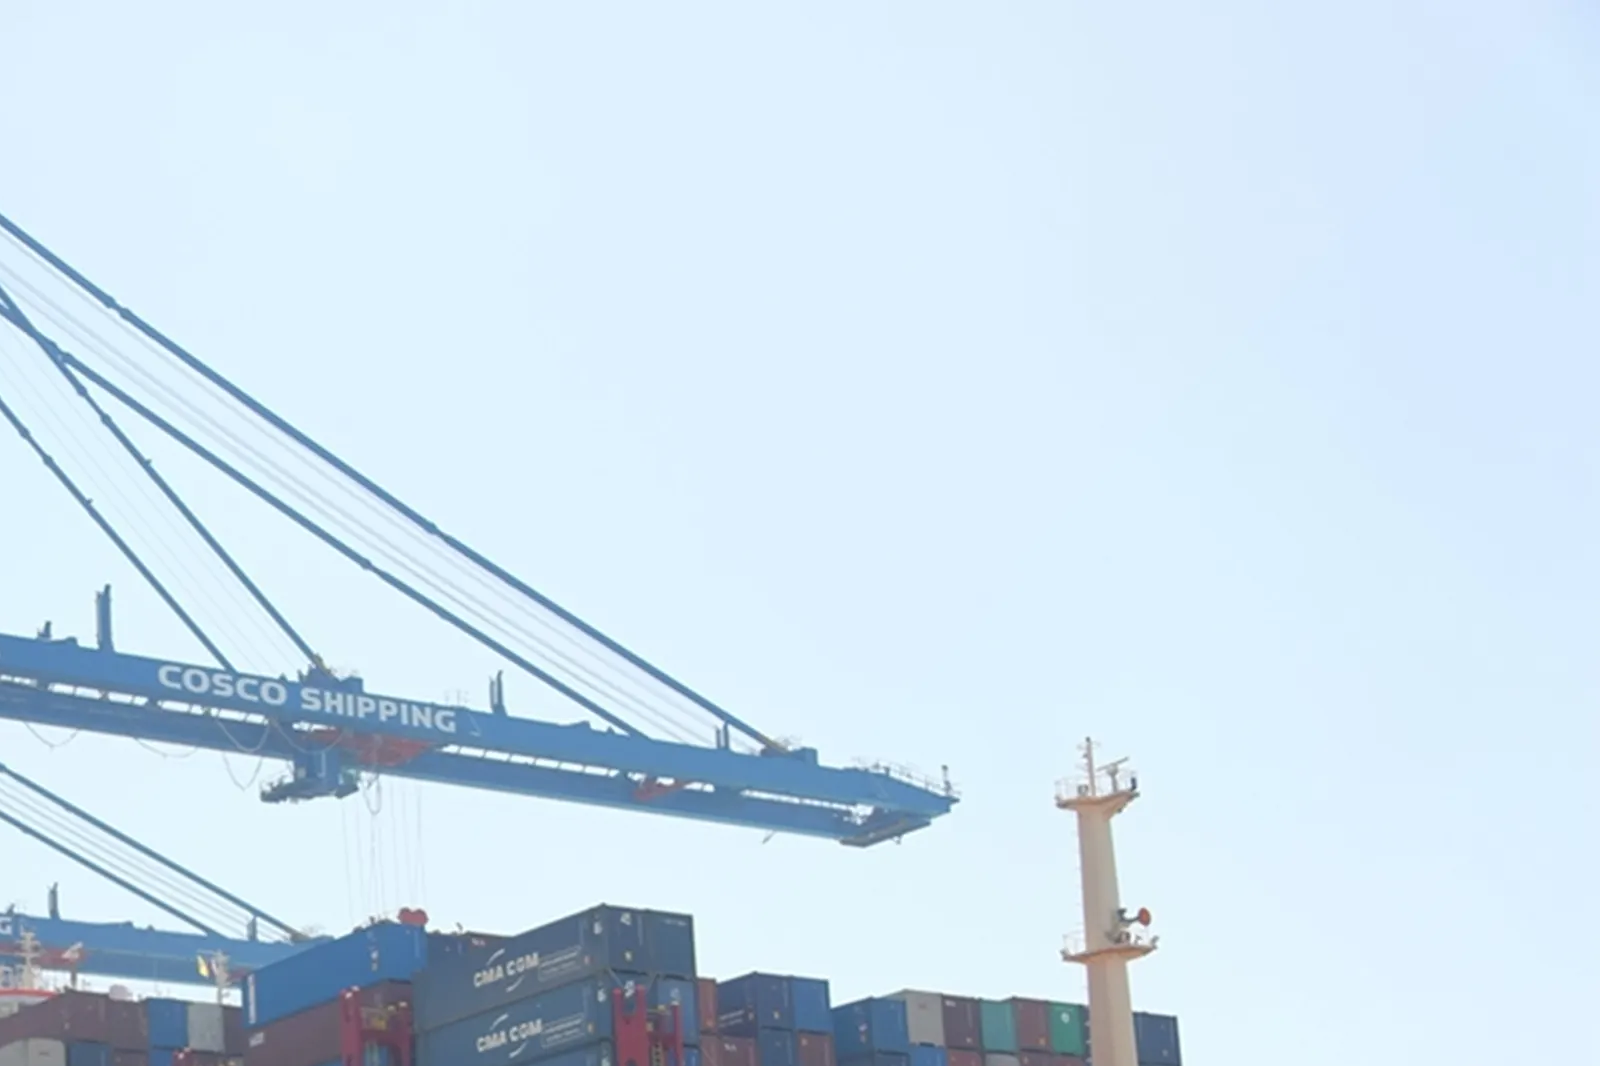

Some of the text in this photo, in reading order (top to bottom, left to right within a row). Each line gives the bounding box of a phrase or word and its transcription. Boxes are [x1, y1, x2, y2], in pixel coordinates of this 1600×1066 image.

[158, 664, 457, 733] COSCO SHIPPING
[473, 968, 504, 988] CMA
[506, 952, 540, 976] CGM
[476, 1033, 507, 1053] CMA
[509, 1018, 543, 1042] CGM
